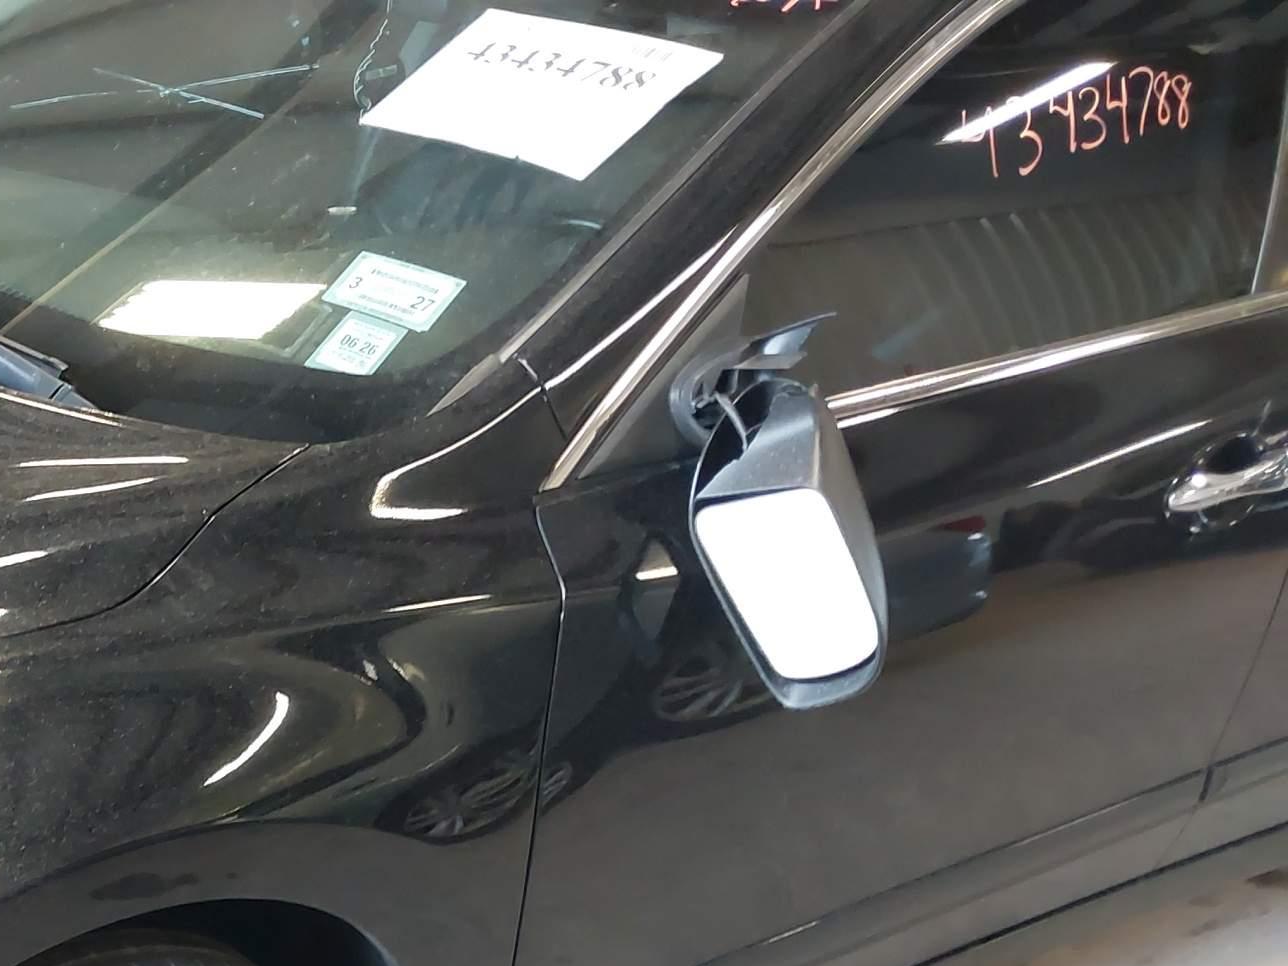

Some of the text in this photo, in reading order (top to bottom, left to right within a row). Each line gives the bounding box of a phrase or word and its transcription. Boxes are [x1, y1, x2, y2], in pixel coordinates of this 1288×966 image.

[467, 41, 657, 91] 43434788
[960, 65, 1193, 179] 43434788
[348, 276, 364, 290] 3
[409, 295, 436, 313] 27
[339, 333, 381, 356] 06 26
